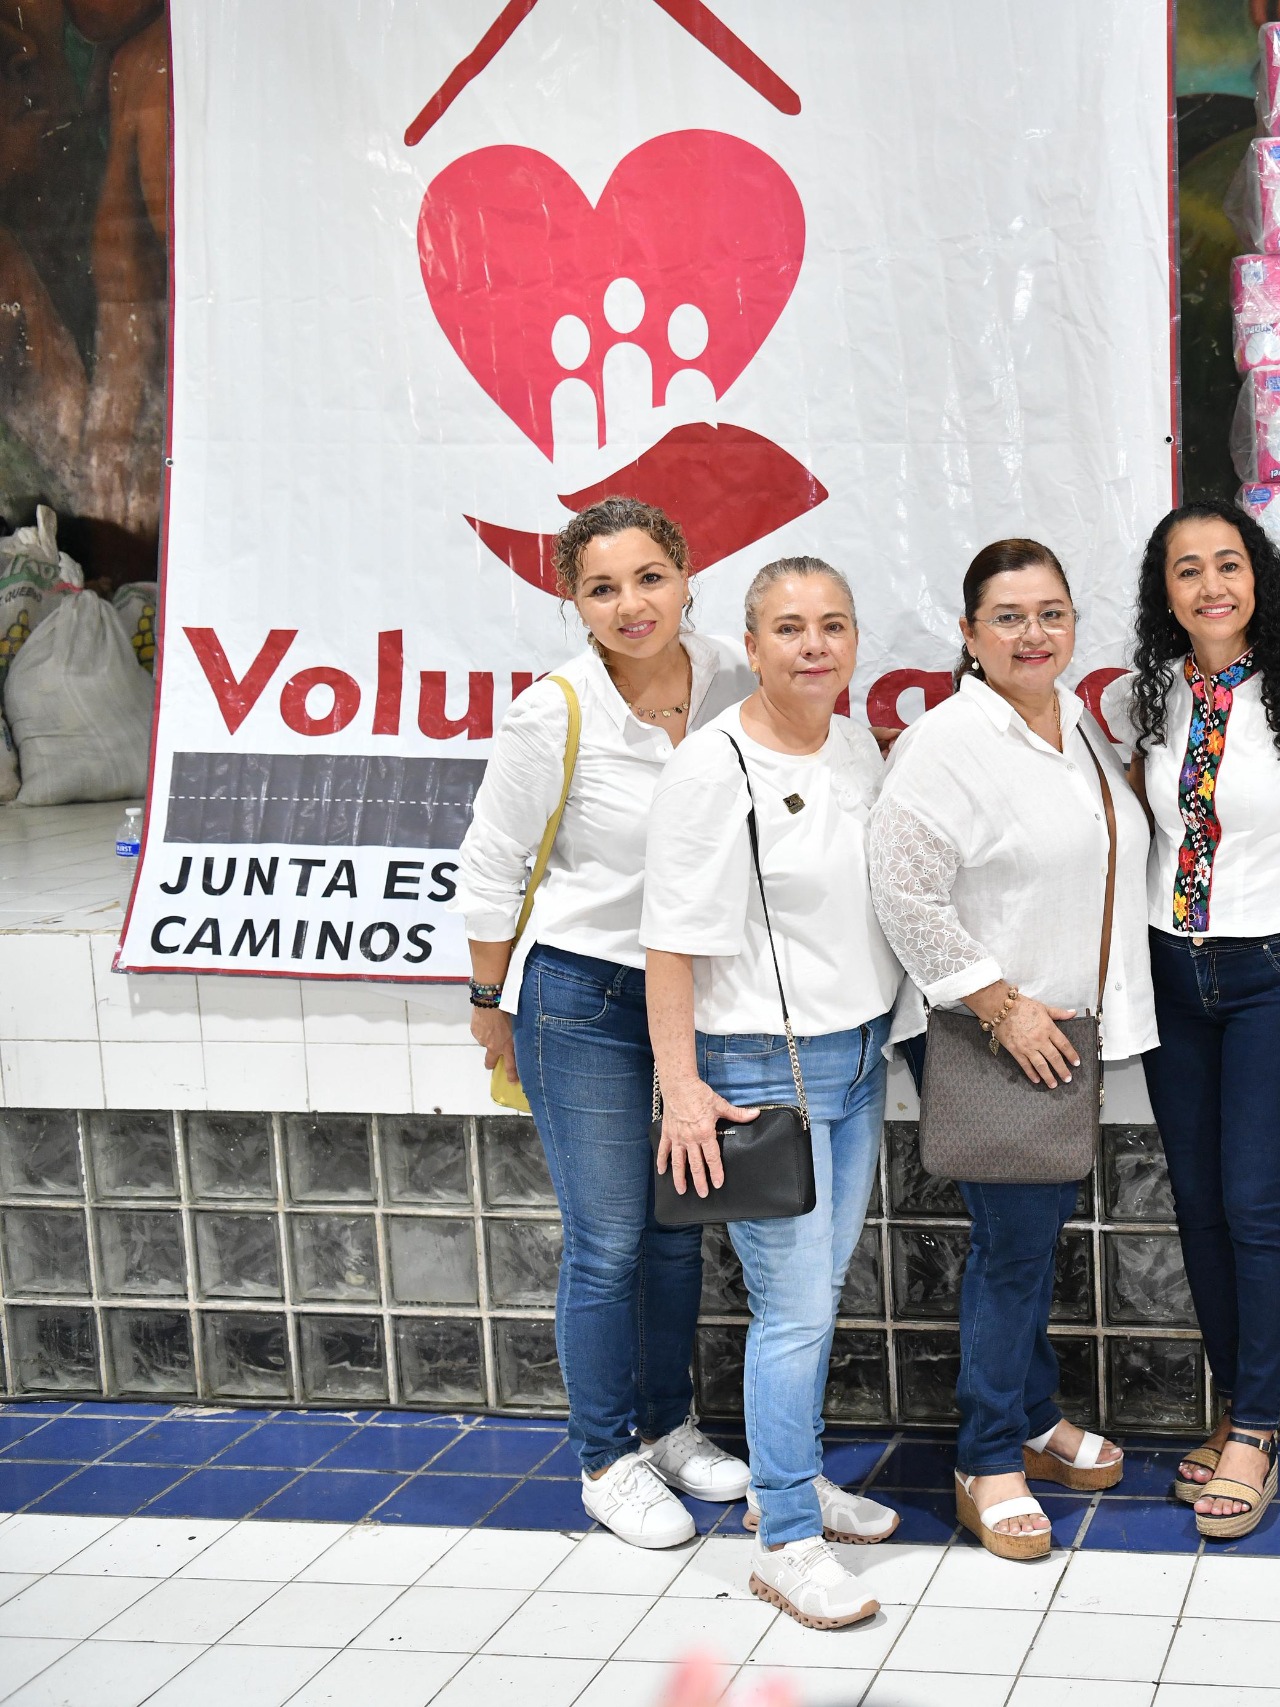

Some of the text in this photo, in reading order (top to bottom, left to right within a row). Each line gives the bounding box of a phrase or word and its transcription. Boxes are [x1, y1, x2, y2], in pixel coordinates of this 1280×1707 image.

[159, 856, 460, 902] JUNTA ES
[150, 914, 436, 964] CAMINOS
